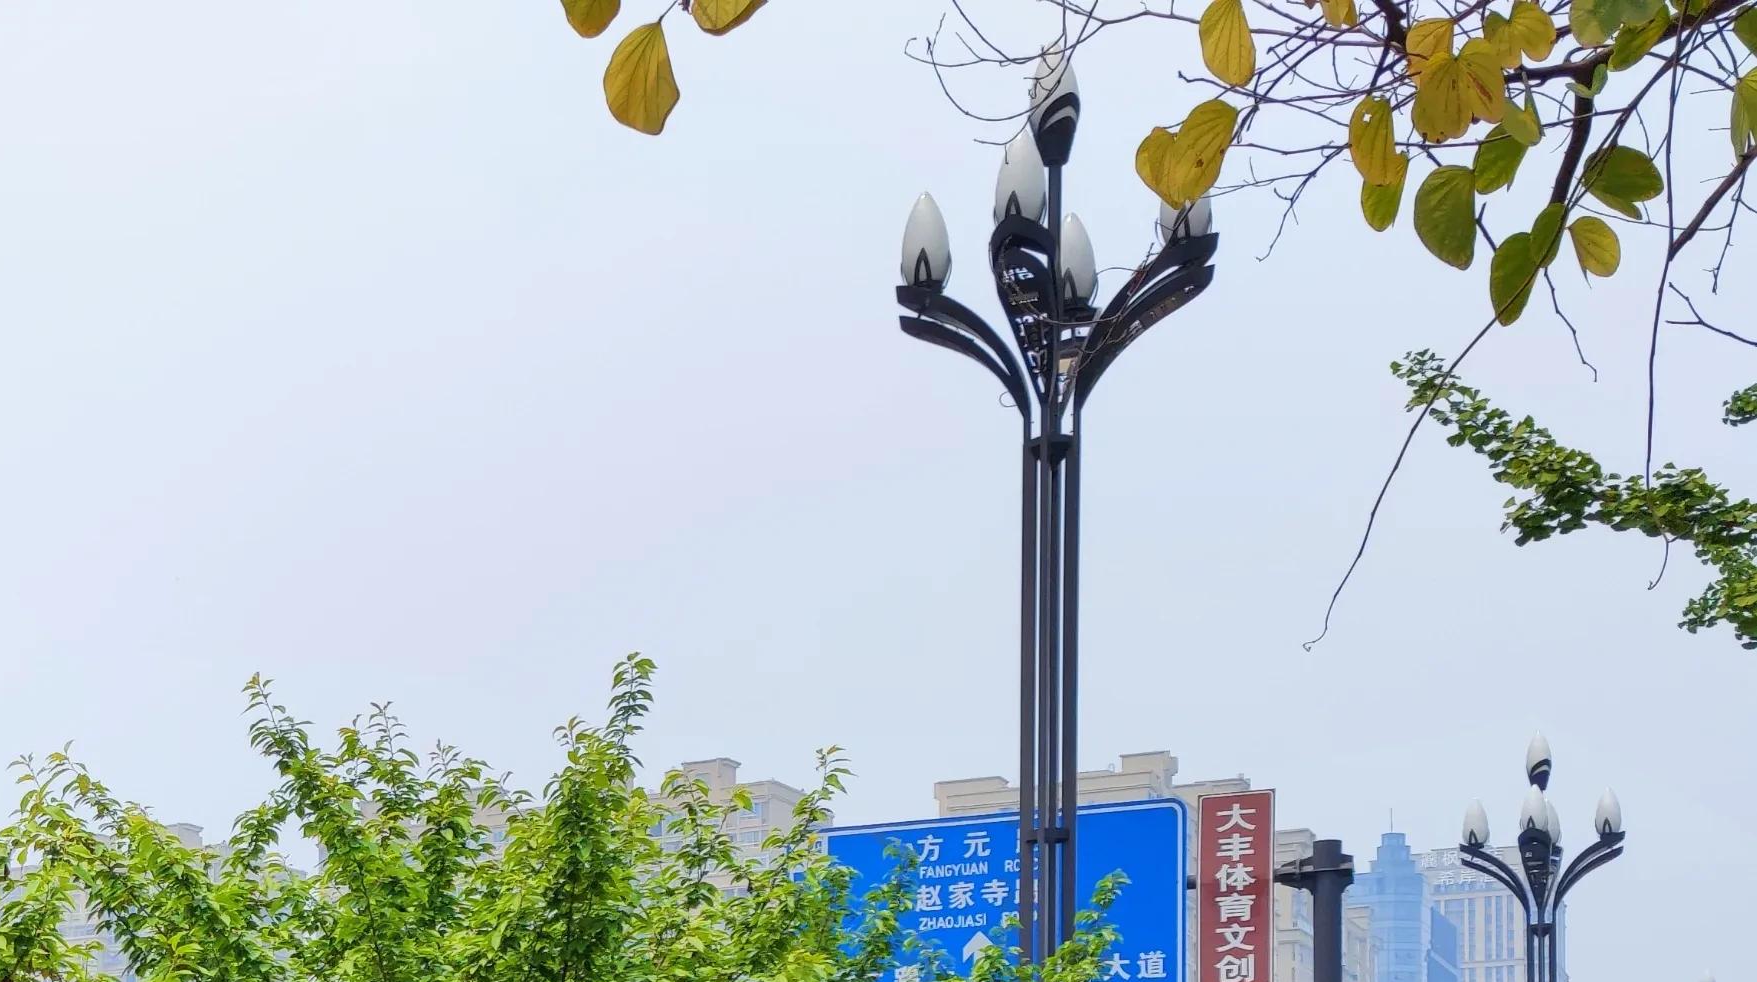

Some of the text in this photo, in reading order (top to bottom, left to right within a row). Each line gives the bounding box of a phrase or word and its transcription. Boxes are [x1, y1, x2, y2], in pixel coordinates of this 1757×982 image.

[919, 855, 1039, 879] FANGYUAN RO
[918, 912, 987, 931] ZHAOJIASI
[1102, 950, 1167, 982] 大道
